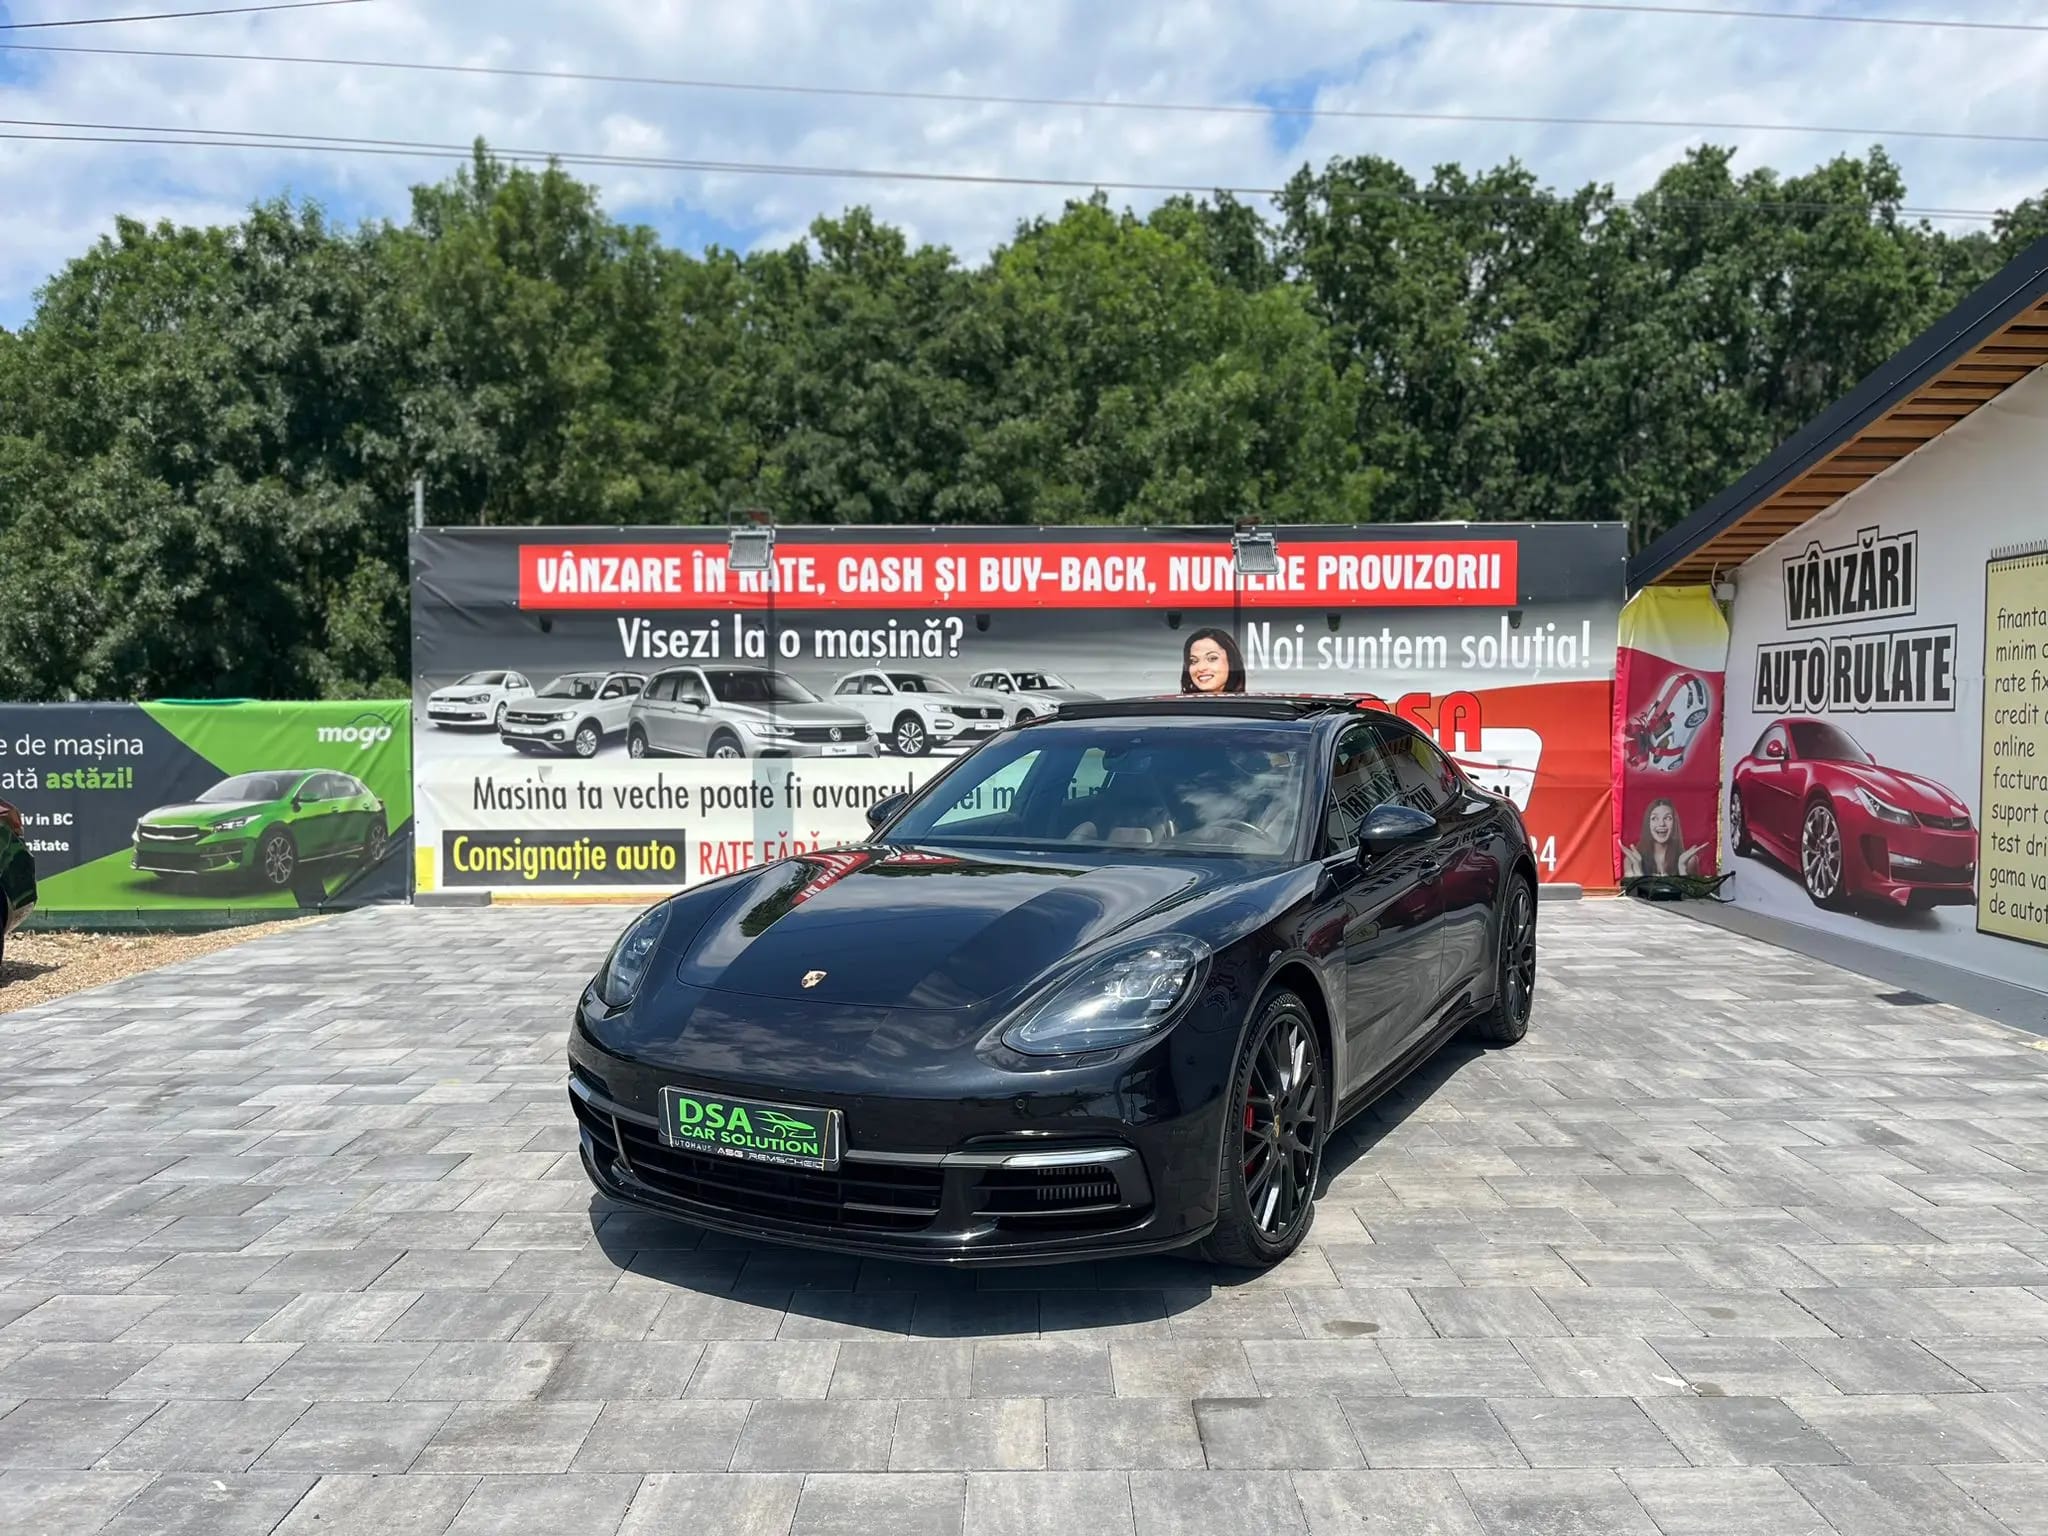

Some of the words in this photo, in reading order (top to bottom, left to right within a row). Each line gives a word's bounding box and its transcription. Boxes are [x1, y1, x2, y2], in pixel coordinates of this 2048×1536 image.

[537, 550, 682, 593] VÂNZARE
[691, 549, 726, 593] ÎN
[738, 557, 826, 595] RATE,
[838, 557, 923, 593] CASH
[935, 556, 967, 601] ȘI
[979, 556, 1157, 594] BUY-BACK,
[1317, 553, 1501, 591] PROVIZORII
[1787, 537, 1912, 621] VÂNZĂRI
[616, 616, 720, 659] Visezi
[733, 613, 766, 659] la
[778, 628, 801, 659] o
[1247, 621, 1304, 671] Noi
[1317, 628, 1447, 671] suntem
[1460, 615, 1591, 680] soluția!
[1996, 638, 2036, 662] minim
[1757, 646, 1825, 707] AUTO
[1833, 635, 1951, 705] RULATE
[1994, 673, 2027, 693] rate
[1994, 702, 2040, 724] credit
[15, 733, 46, 755] de
[54, 733, 144, 760] mașina
[317, 726, 392, 750] mogo
[1993, 734, 2035, 757] online
[46, 767, 133, 789] astăzi!
[473, 776, 567, 810] Masina
[577, 780, 602, 809] ta
[613, 773, 689, 810] veche
[700, 780, 774, 817] poate
[784, 772, 802, 808] fi
[36, 814, 49, 825] in
[53, 813, 73, 825] BC
[1991, 803, 2039, 827] suport
[1991, 831, 2021, 853] test
[453, 835, 607, 880] Consignație
[616, 840, 676, 871] auto
[699, 842, 754, 875] RATE
[1989, 867, 2026, 889] gama
[1989, 892, 2006, 916] de
[679, 1098, 753, 1133] DSA
[680, 1124, 716, 1141] CAR
[720, 1131, 818, 1155] SOLUTION
